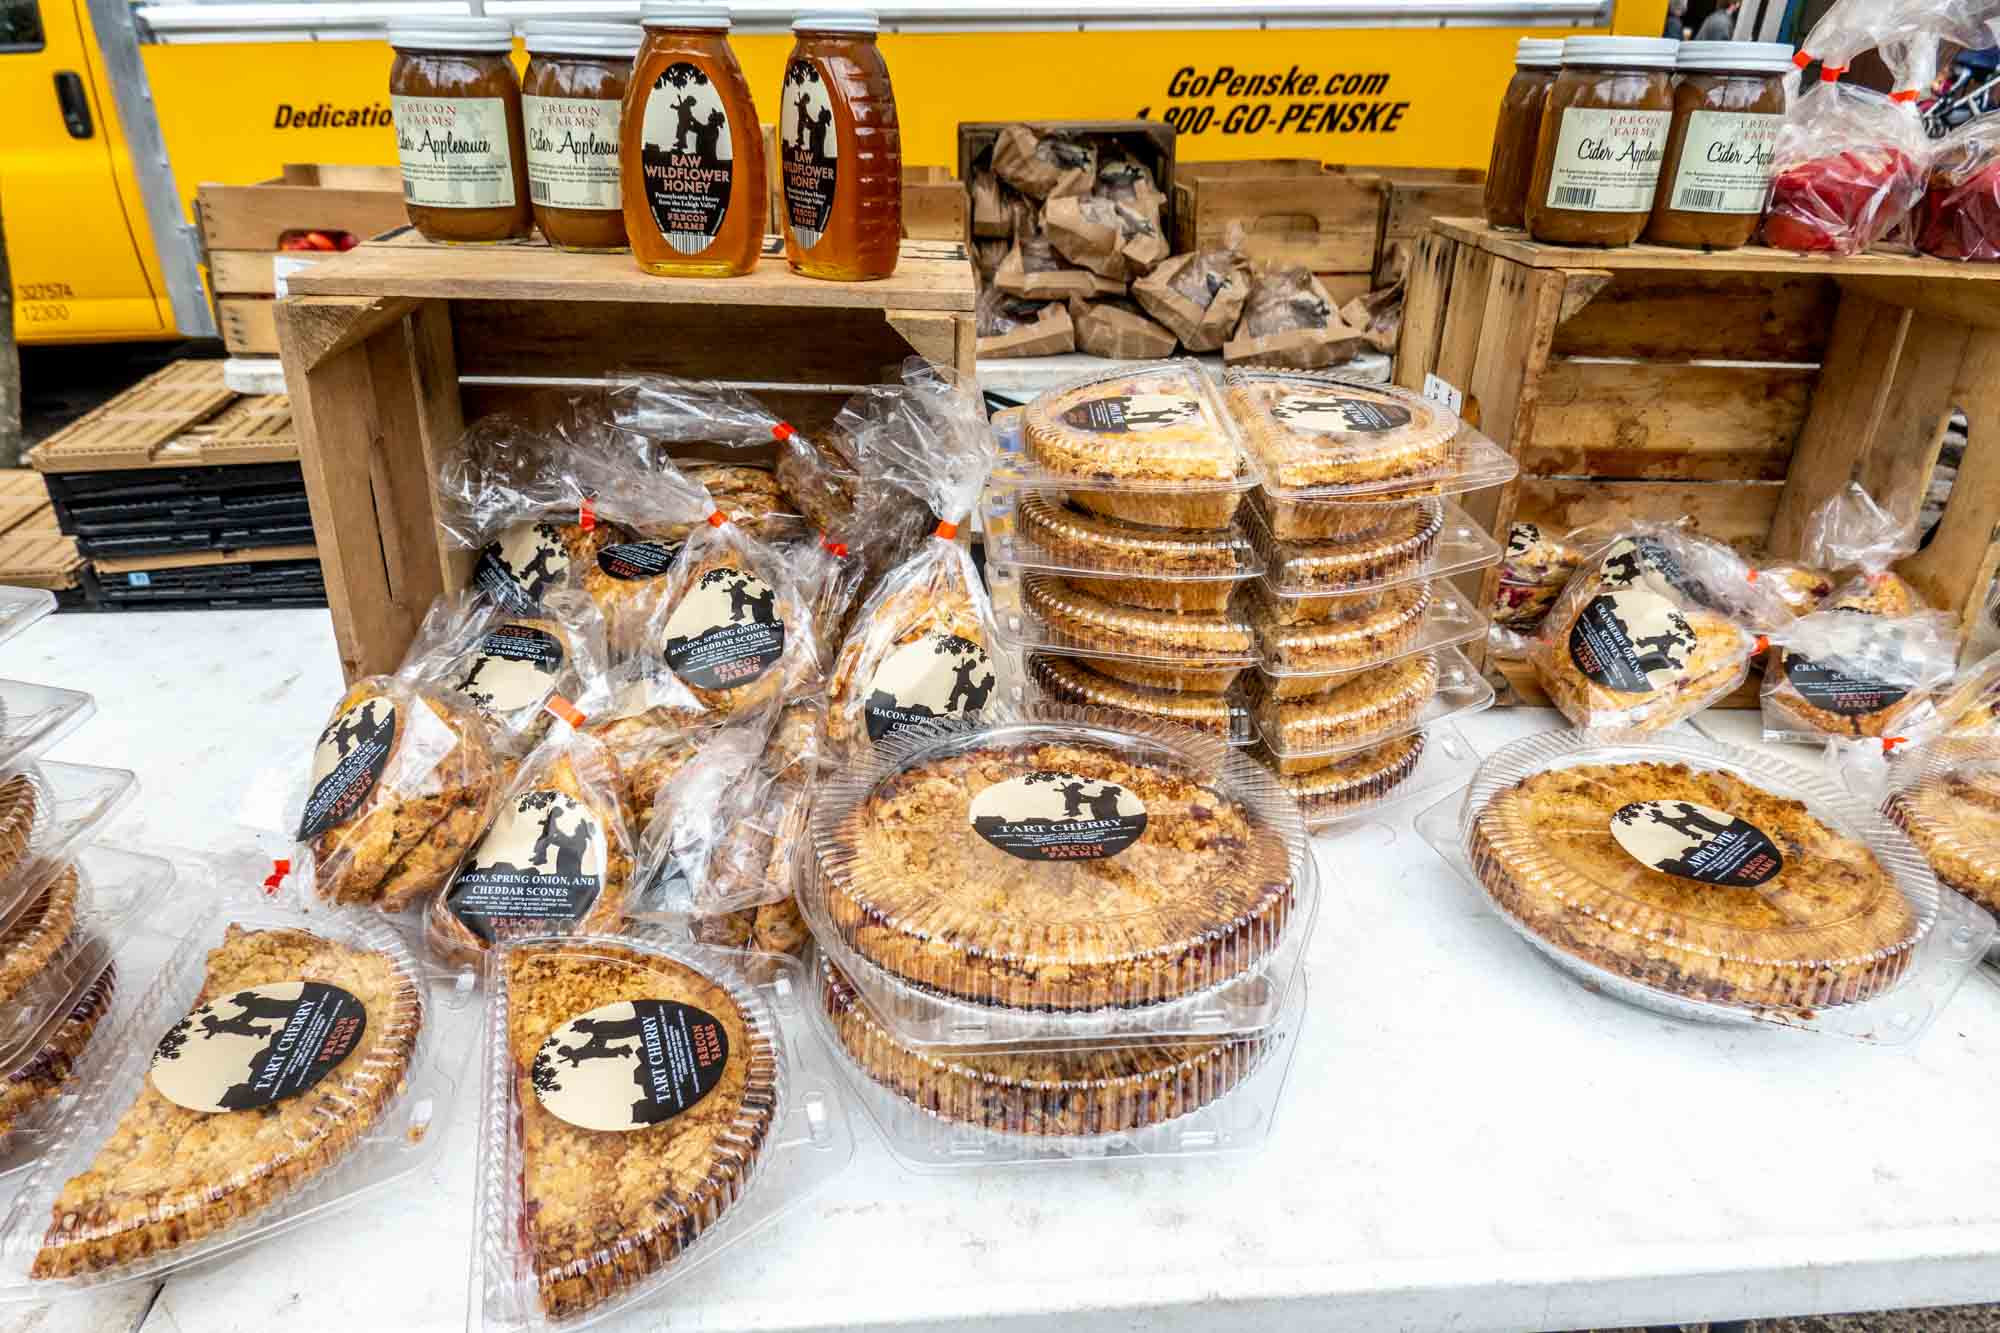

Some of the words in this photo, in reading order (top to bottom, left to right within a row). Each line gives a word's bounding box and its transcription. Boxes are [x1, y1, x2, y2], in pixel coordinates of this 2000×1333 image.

[1167, 65, 1391, 98] GoPenske.com
[1136, 102, 1410, 135] 800-GO-PENSKE
[417, 128, 491, 162] Applesauce
[529, 127, 553, 152] Cider
[1577, 137, 1614, 161] Cider
[1706, 141, 1744, 163] Cider
[644, 163, 730, 183] WILDFLOWER
[671, 154, 702, 168] RAW
[783, 161, 835, 181] WILDFLOWER
[663, 179, 711, 194] HONEY
[789, 173, 820, 192] HONEY
[671, 639, 703, 656] BACON,
[703, 628, 736, 643] SPRING
[736, 623, 770, 636] ONION,
[690, 638, 734, 656] CHEDDAR
[735, 629, 771, 644] SCONES
[1594, 602, 1628, 647] CRANBERRY
[1623, 646, 1647, 684] ORANGE
[1599, 629, 1622, 661] SCONES
[872, 706, 908, 722] BACON,
[999, 825, 1046, 833] TART
[1050, 818, 1122, 832] CHERRY
[1688, 843, 1723, 869] APPLE
[1712, 831, 1738, 847] PIE
[472, 885, 524, 896] CHEDDAR
[525, 887, 569, 898] SCONES
[490, 874, 528, 885] SPRING
[531, 875, 570, 885] ONION,
[572, 876, 595, 887] AND
[253, 1053, 286, 1092] TART
[276, 999, 317, 1052] CHERRY
[642, 1015, 664, 1066] CHERRY
[691, 1023, 713, 1068] FRECON
[704, 1022, 722, 1061] FARMS
[651, 1067, 671, 1105] TART
